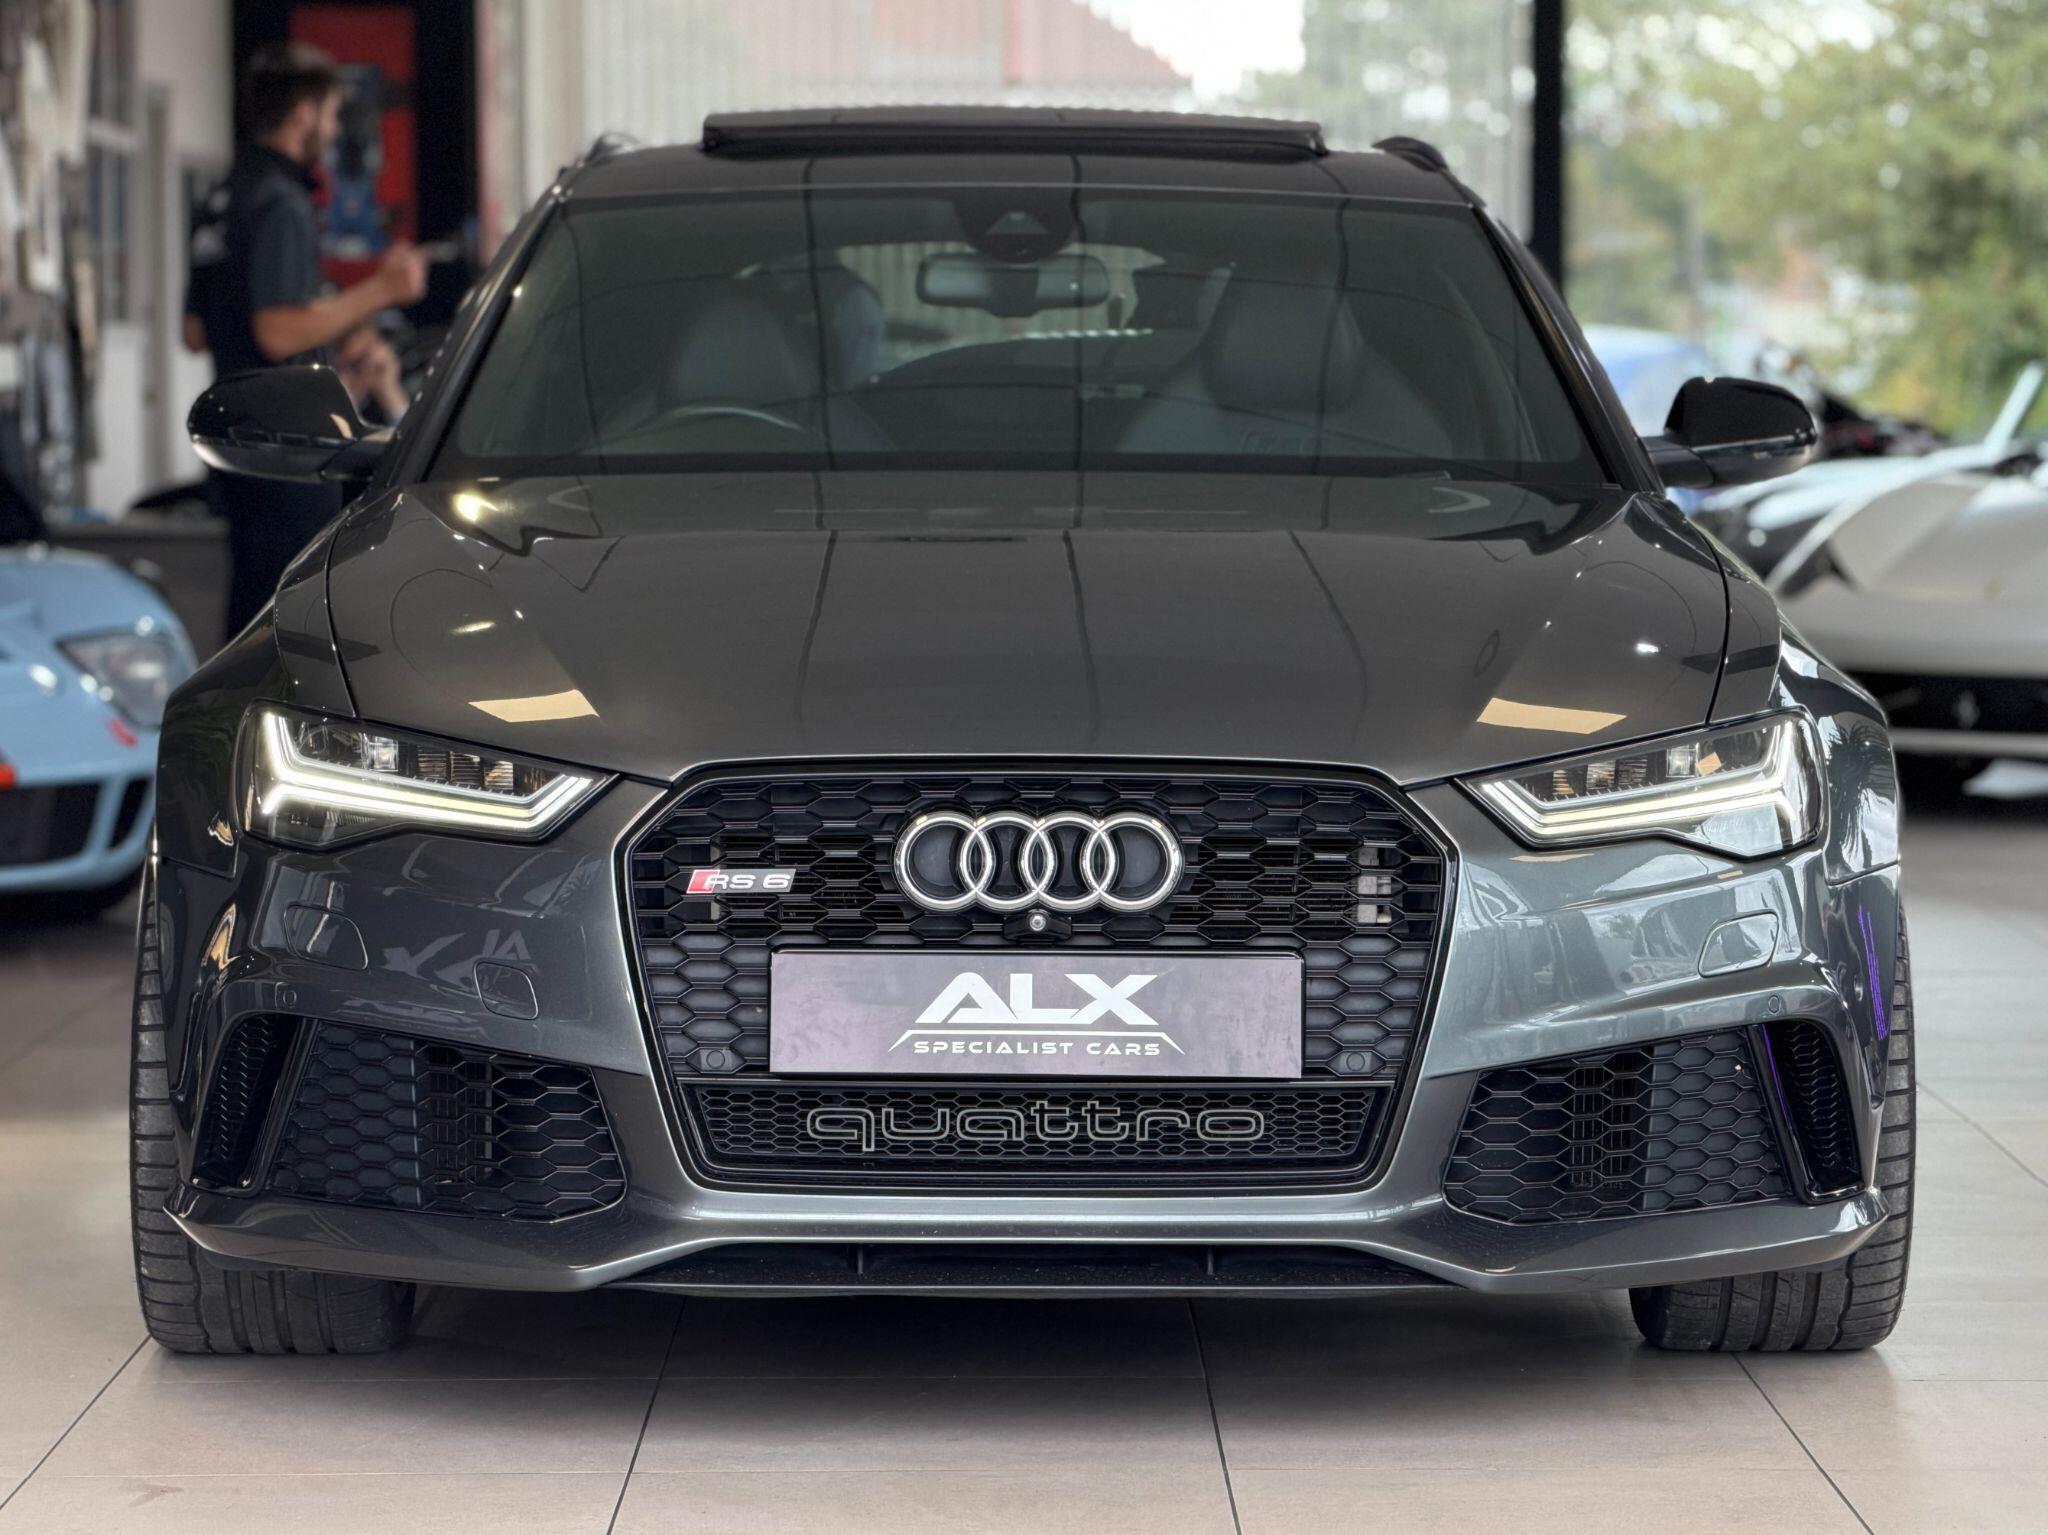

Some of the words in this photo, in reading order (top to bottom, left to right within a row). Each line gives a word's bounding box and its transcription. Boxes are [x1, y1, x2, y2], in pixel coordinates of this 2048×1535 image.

[703, 874, 756, 890] RS
[762, 873, 791, 889] 6
[914, 972, 1160, 1026] ALX
[913, 1040, 1074, 1055] SPECIALIST
[1086, 1042, 1161, 1056] CARS
[806, 1101, 1265, 1152] quattro
